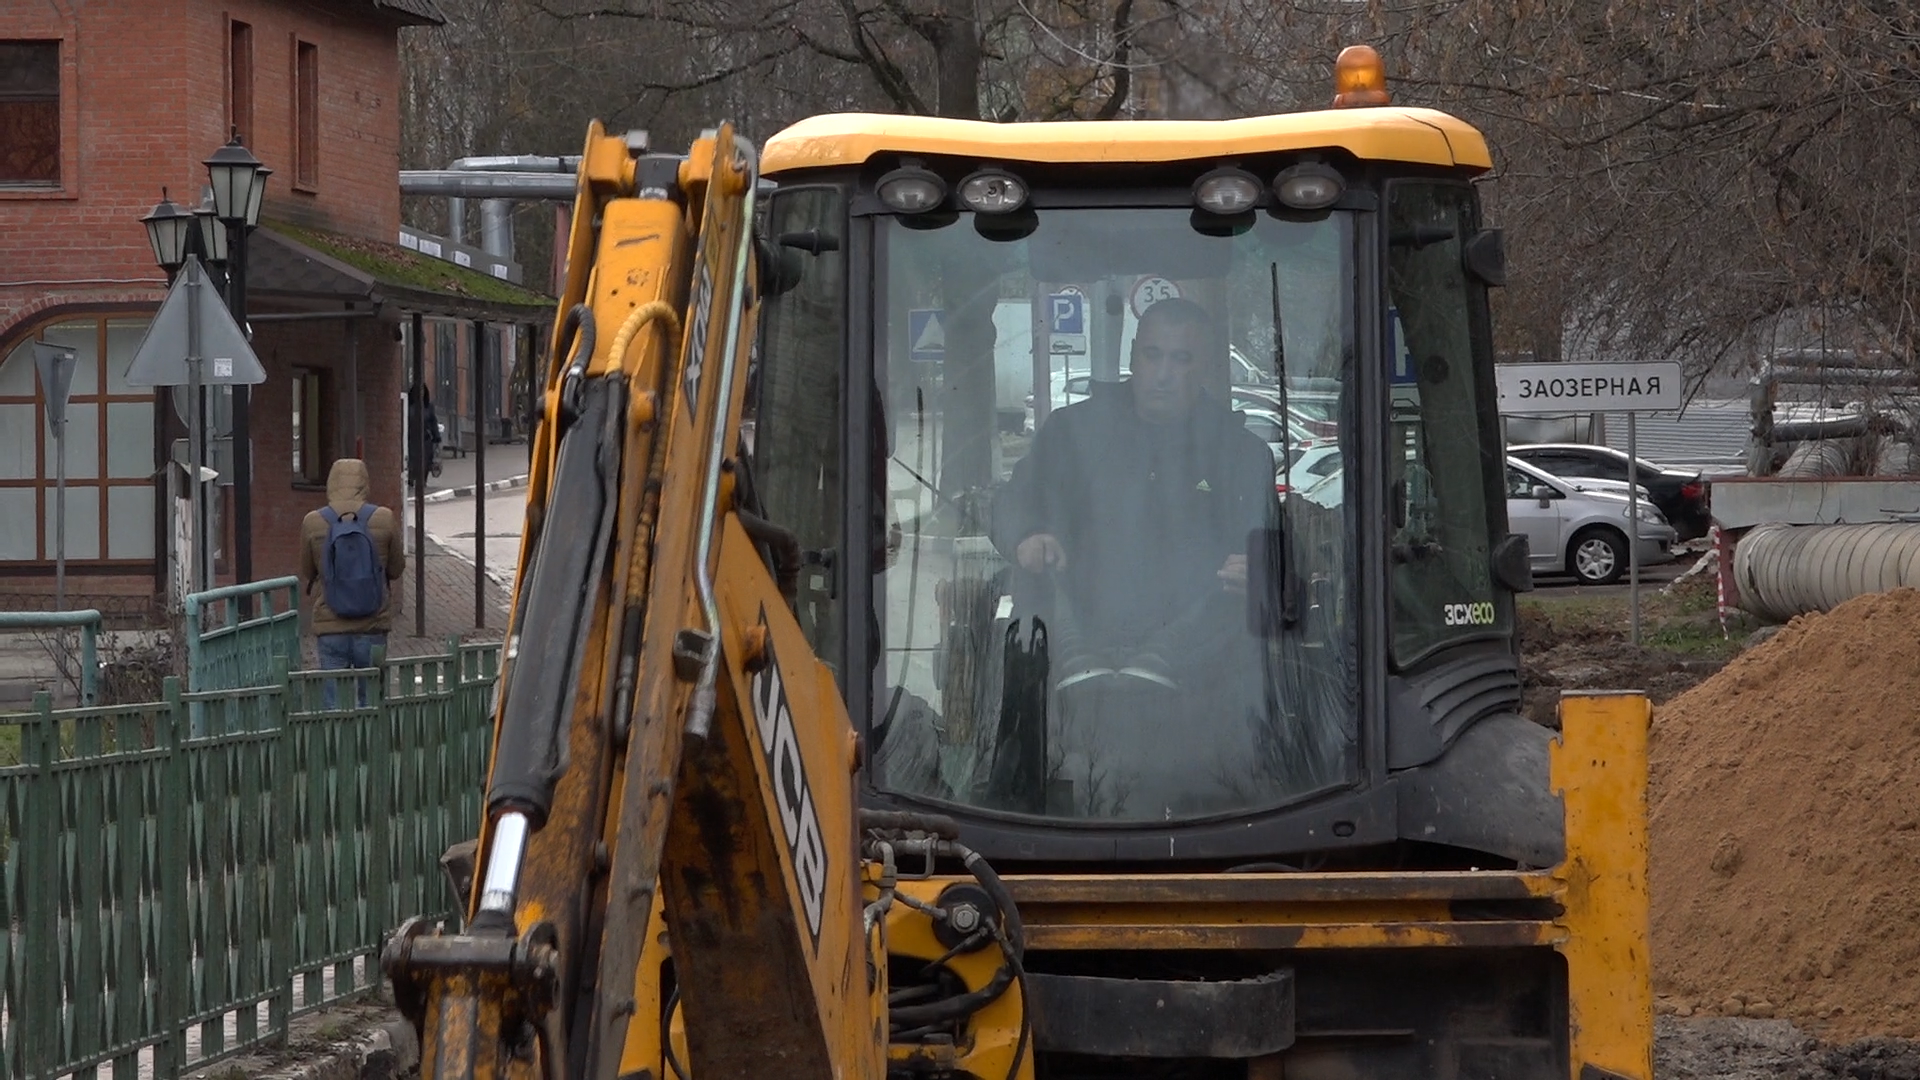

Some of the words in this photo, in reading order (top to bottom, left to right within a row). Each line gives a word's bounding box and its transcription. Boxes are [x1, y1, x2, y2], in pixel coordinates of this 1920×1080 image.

[1053, 298, 1075, 331] P
[1519, 376, 1661, 399] ЗАОЗЕРНАЯ
[752, 662, 826, 937] JCB
